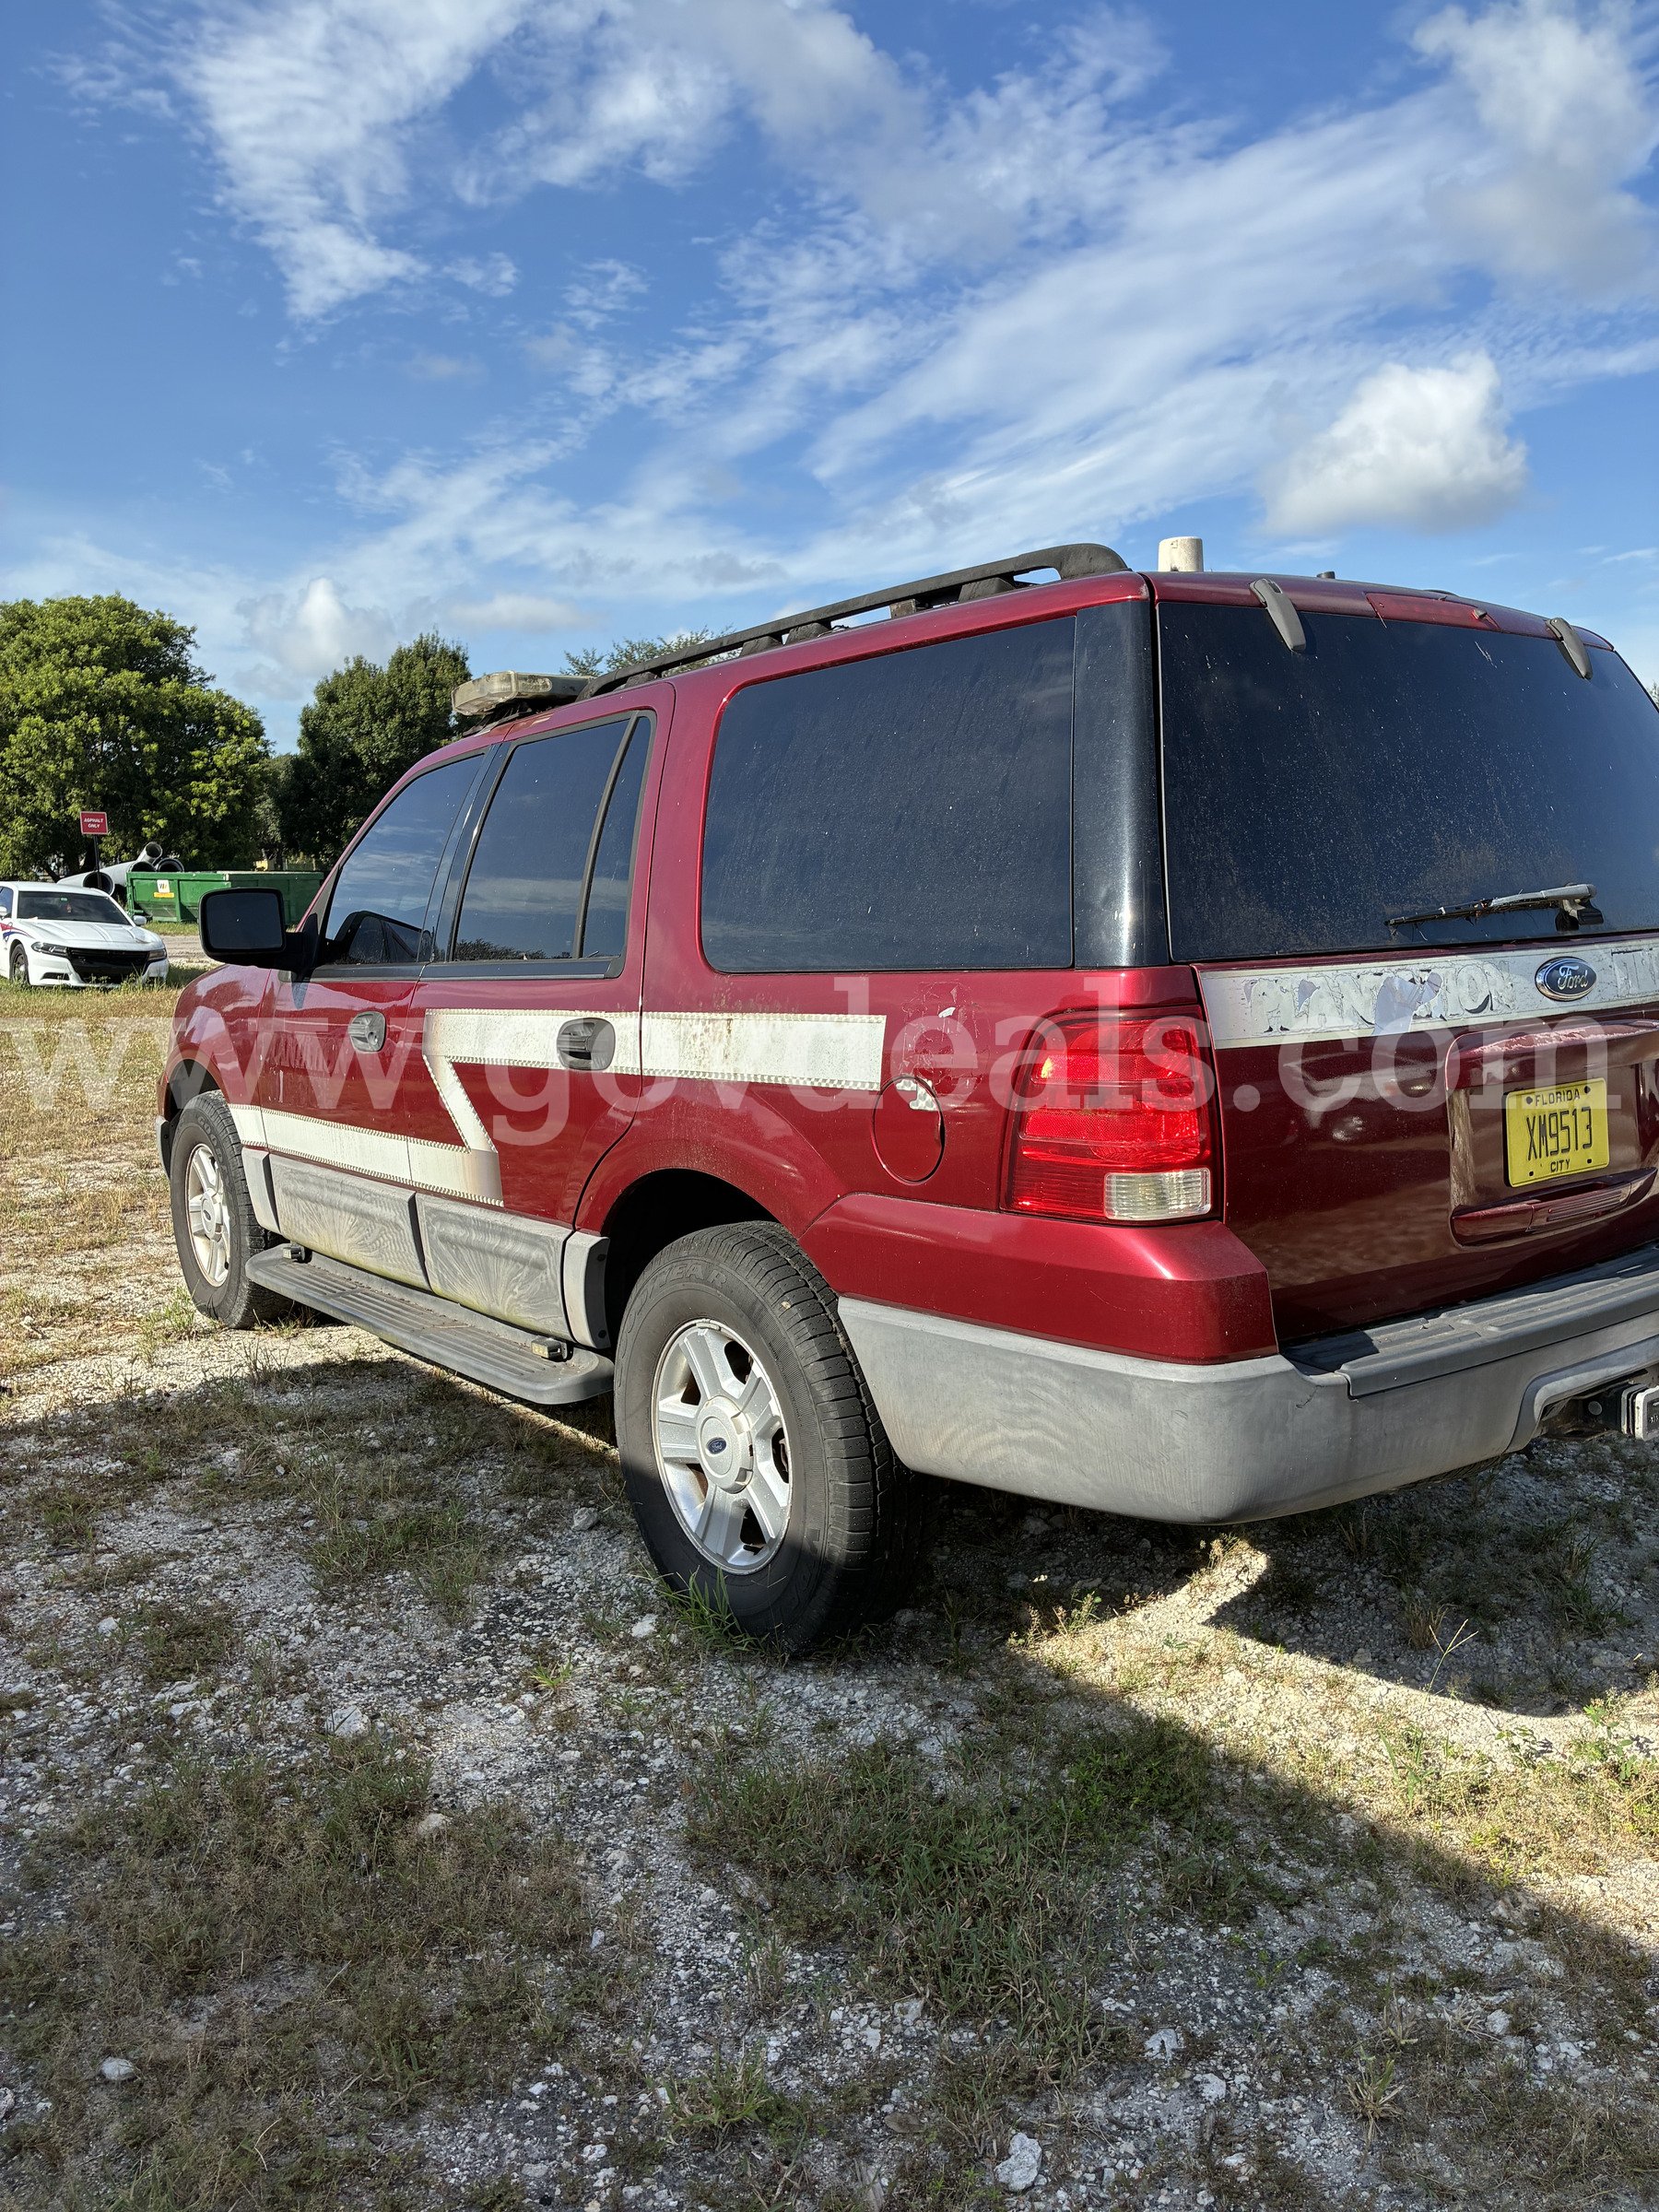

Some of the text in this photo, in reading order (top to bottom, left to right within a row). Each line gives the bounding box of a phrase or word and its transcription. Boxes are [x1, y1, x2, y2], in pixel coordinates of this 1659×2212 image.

[1557, 965, 1589, 991] Ford
[1535, 1088, 1581, 1106] FLORIDA
[1526, 1106, 1593, 1161] XM9513
[1550, 1159, 1571, 1172] CITY
